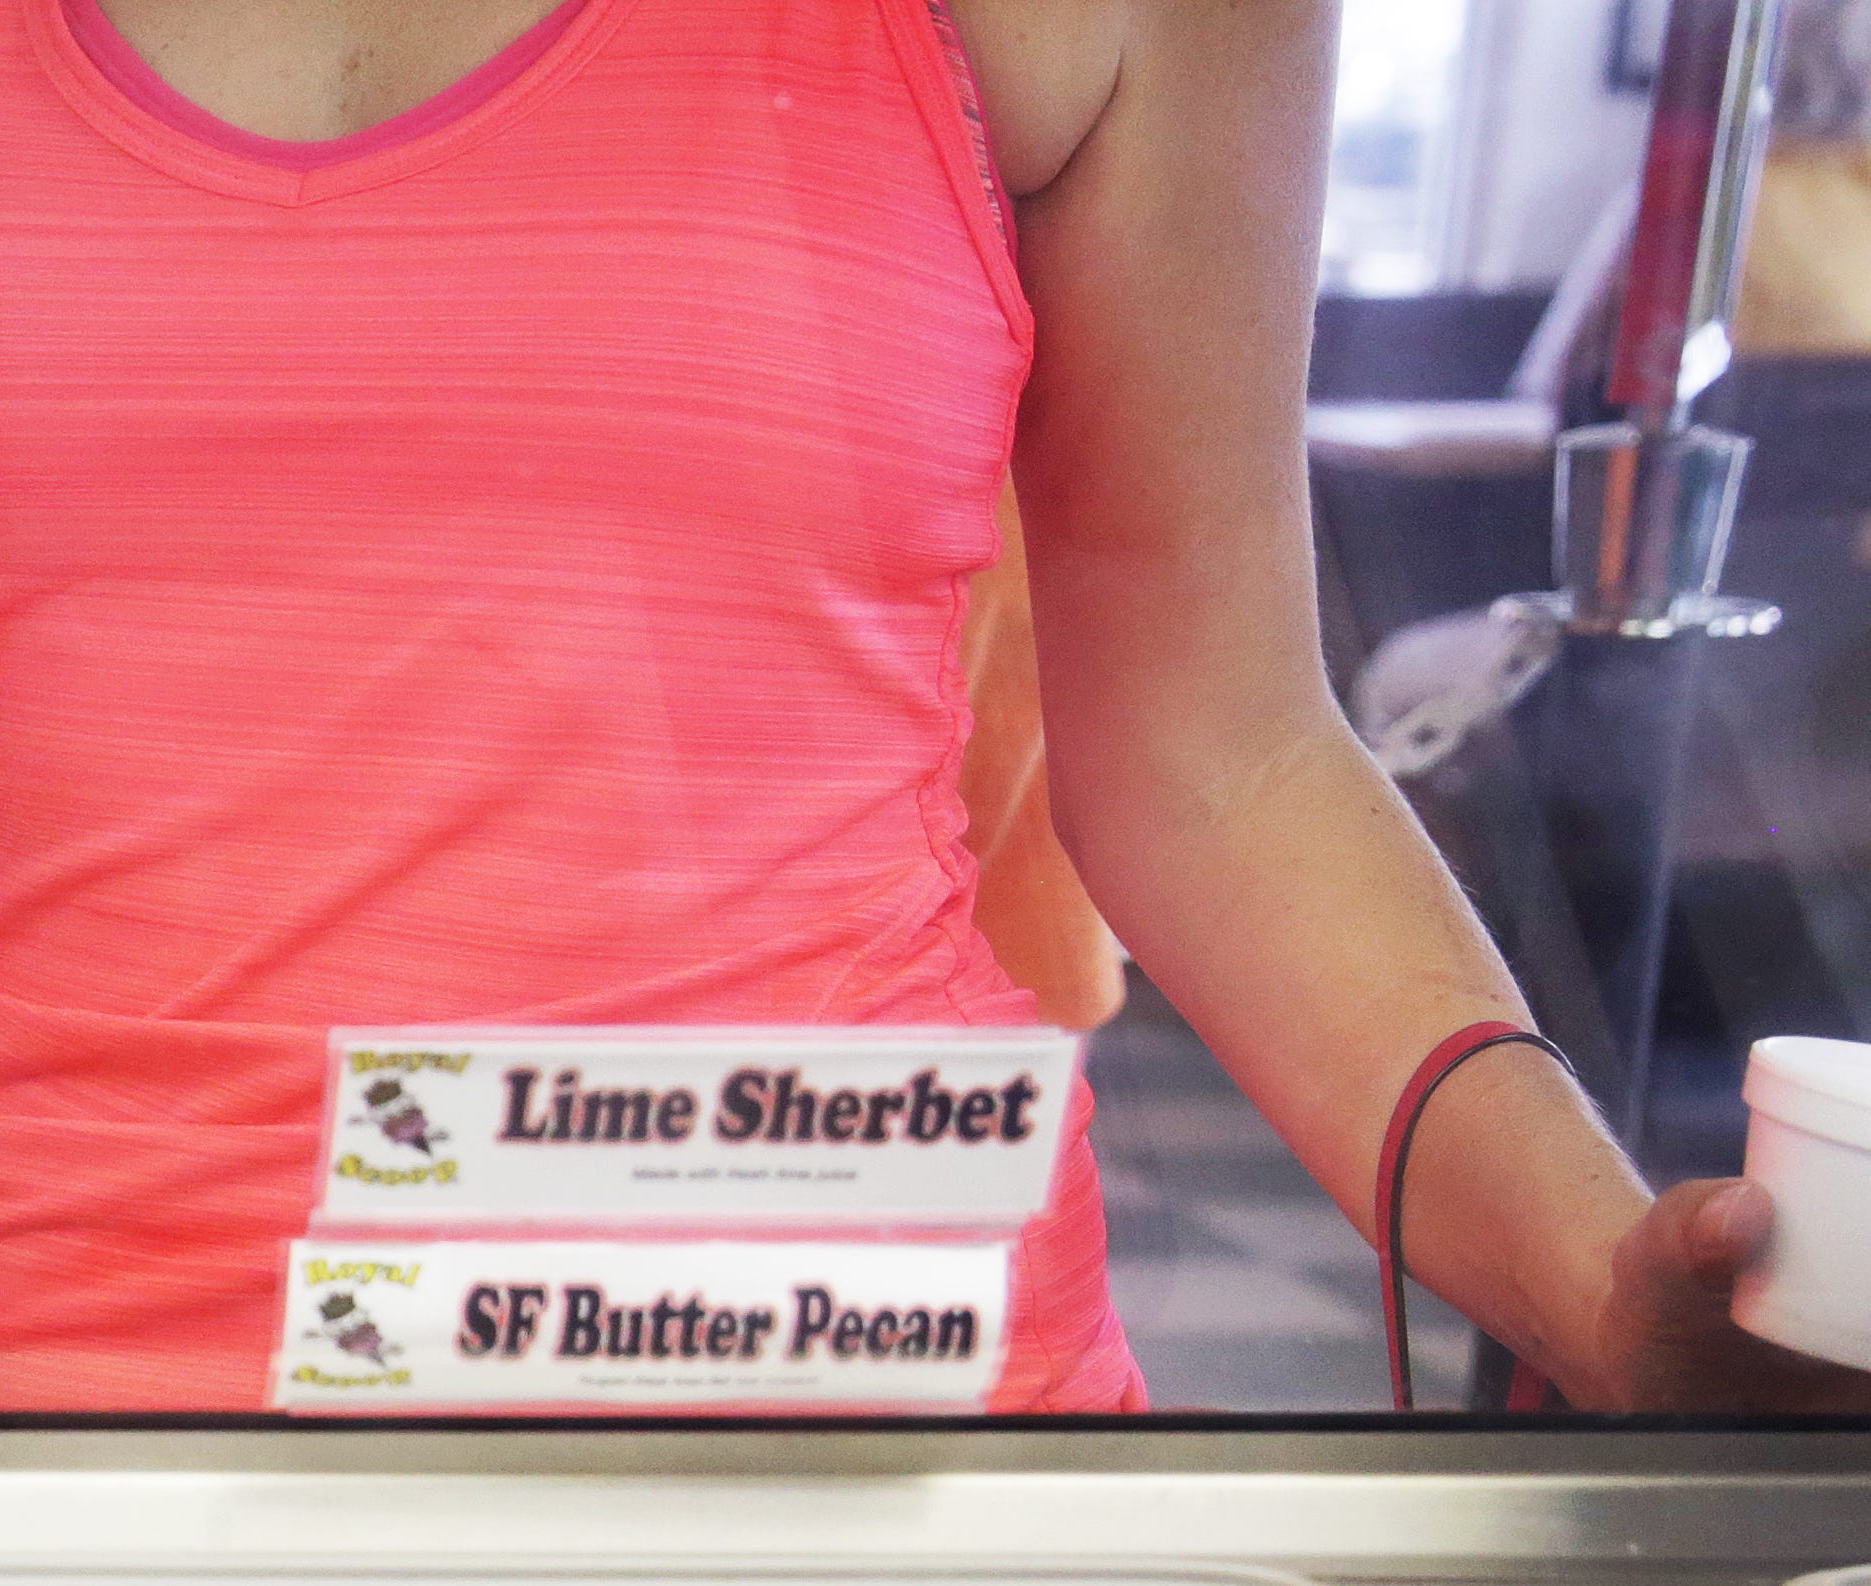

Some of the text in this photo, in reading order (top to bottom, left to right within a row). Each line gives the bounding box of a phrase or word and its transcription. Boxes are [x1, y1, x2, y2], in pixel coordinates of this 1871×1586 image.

[498, 1066, 1039, 1145] Lime Sherbet
[456, 1282, 980, 1361] SF Butter Pecan
